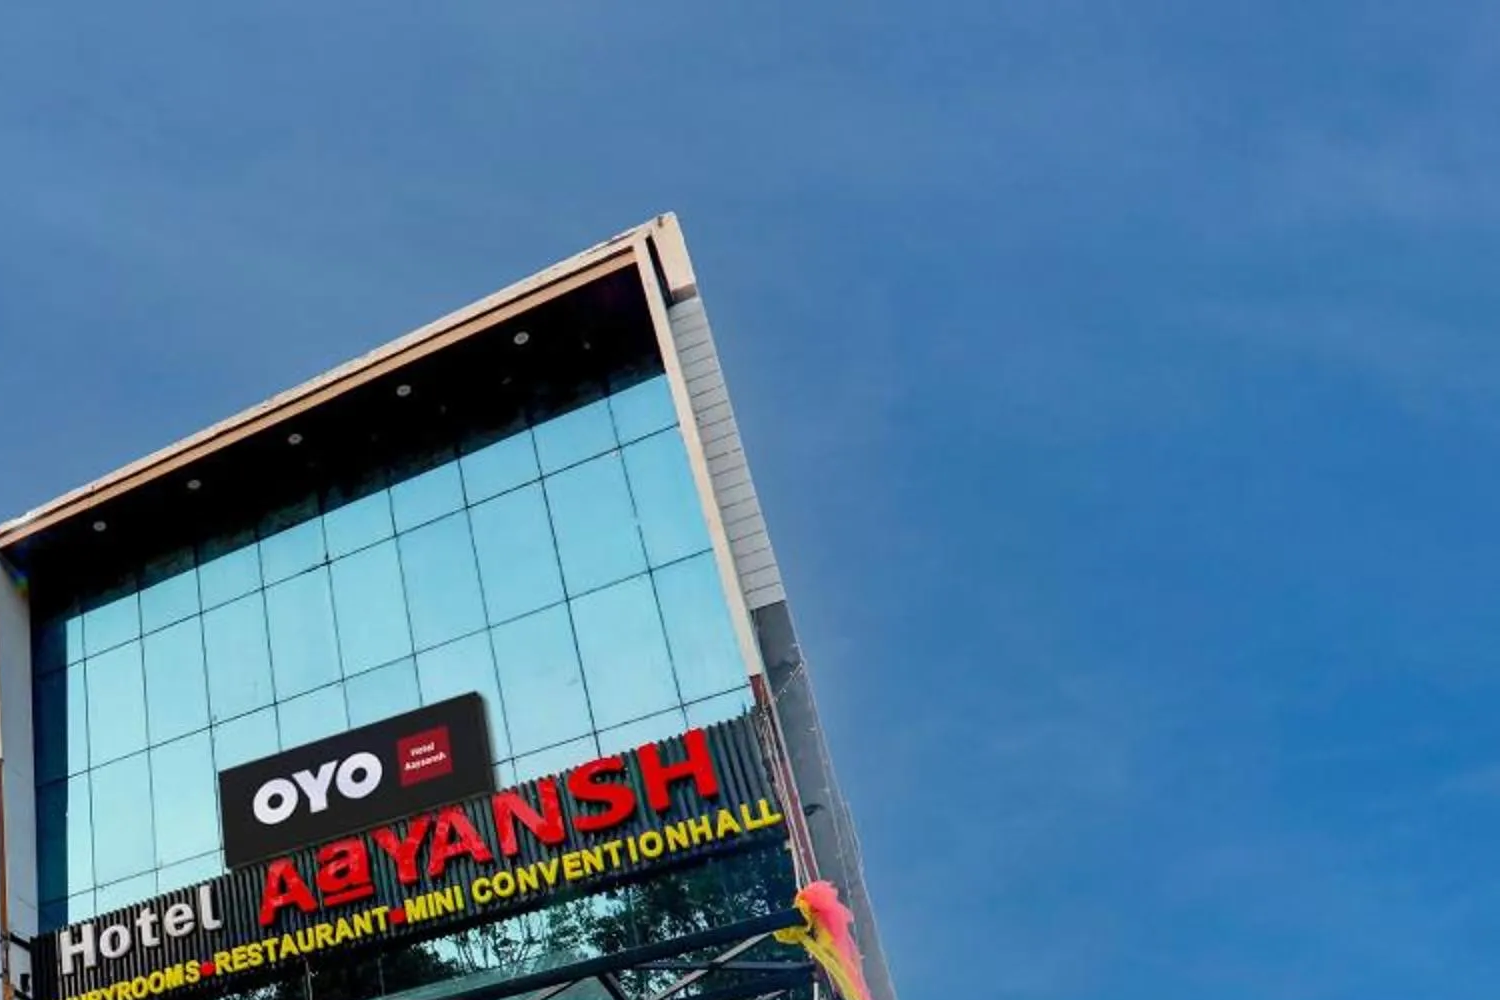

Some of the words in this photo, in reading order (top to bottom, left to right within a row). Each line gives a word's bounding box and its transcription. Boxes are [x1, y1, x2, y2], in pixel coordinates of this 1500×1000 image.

[253, 752, 383, 825] OYO
[59, 885, 223, 975] Hotel
[258, 727, 721, 925] AaYANSH
[214, 905, 391, 976] RESTAURANT
[404, 884, 465, 924] MINI
